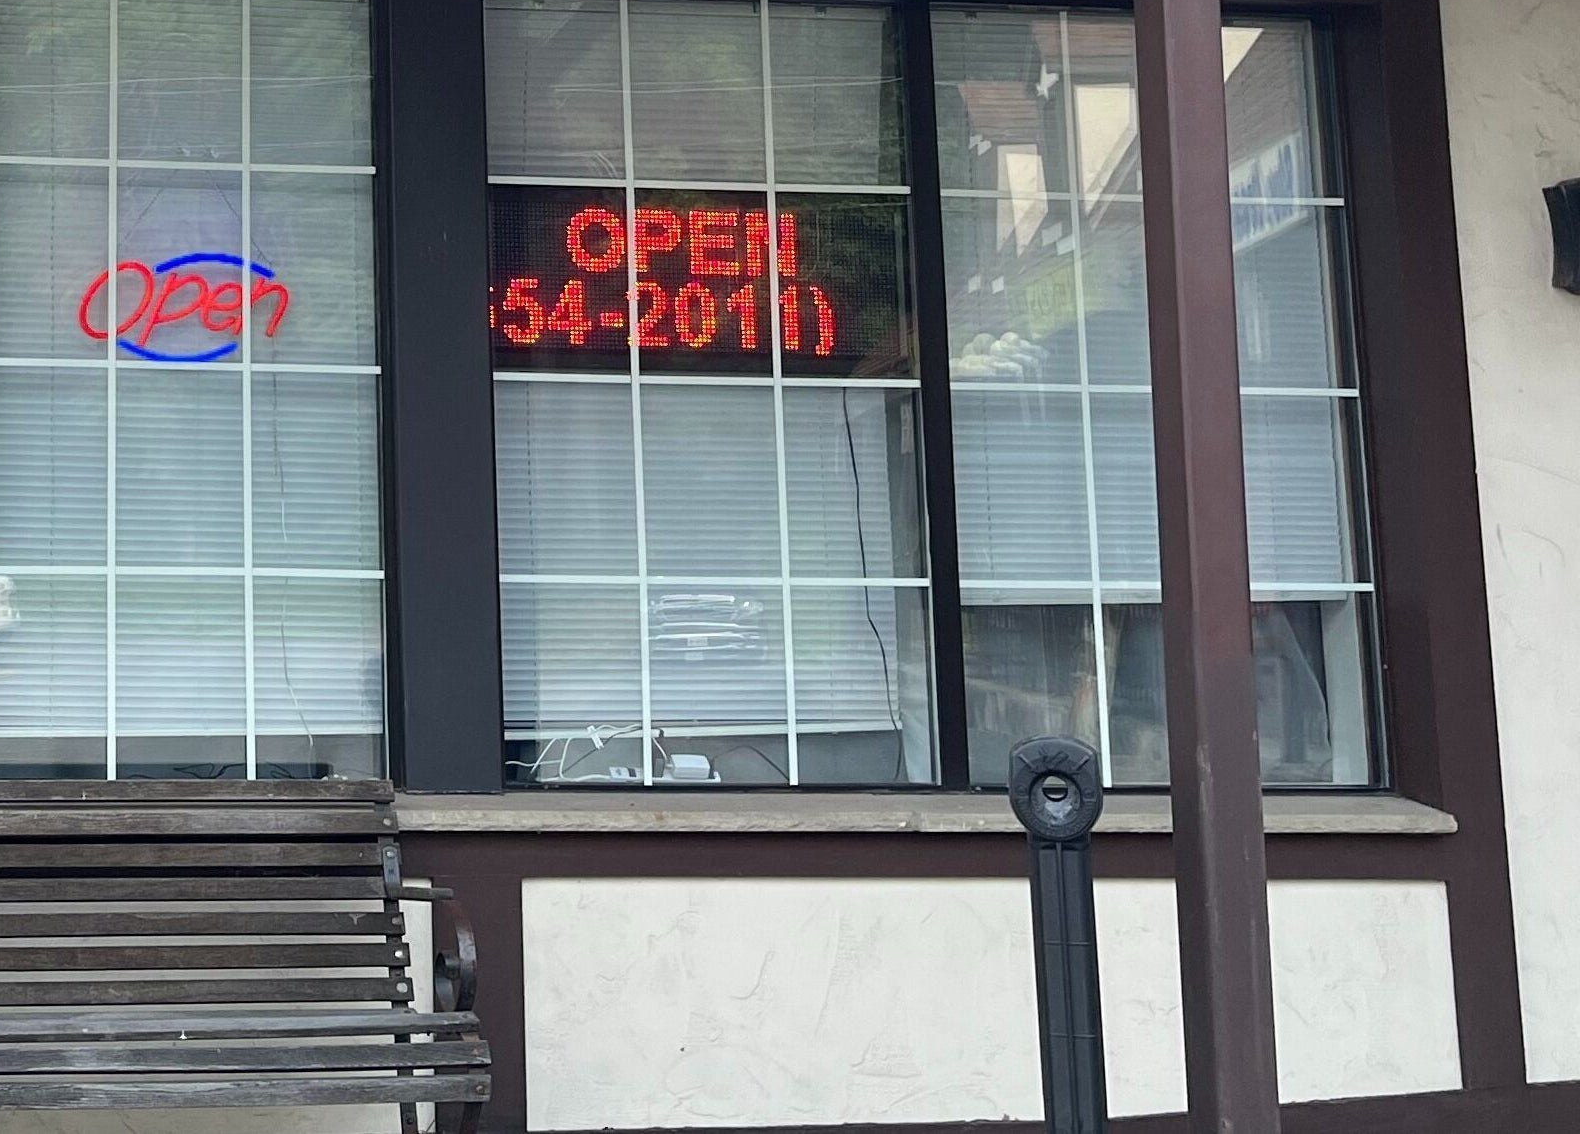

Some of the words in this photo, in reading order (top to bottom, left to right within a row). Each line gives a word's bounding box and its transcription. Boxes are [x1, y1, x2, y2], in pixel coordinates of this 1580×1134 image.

[566, 206, 798, 278] OPEN
[78, 260, 290, 347] Open
[488, 277, 837, 357] 54-2011)
